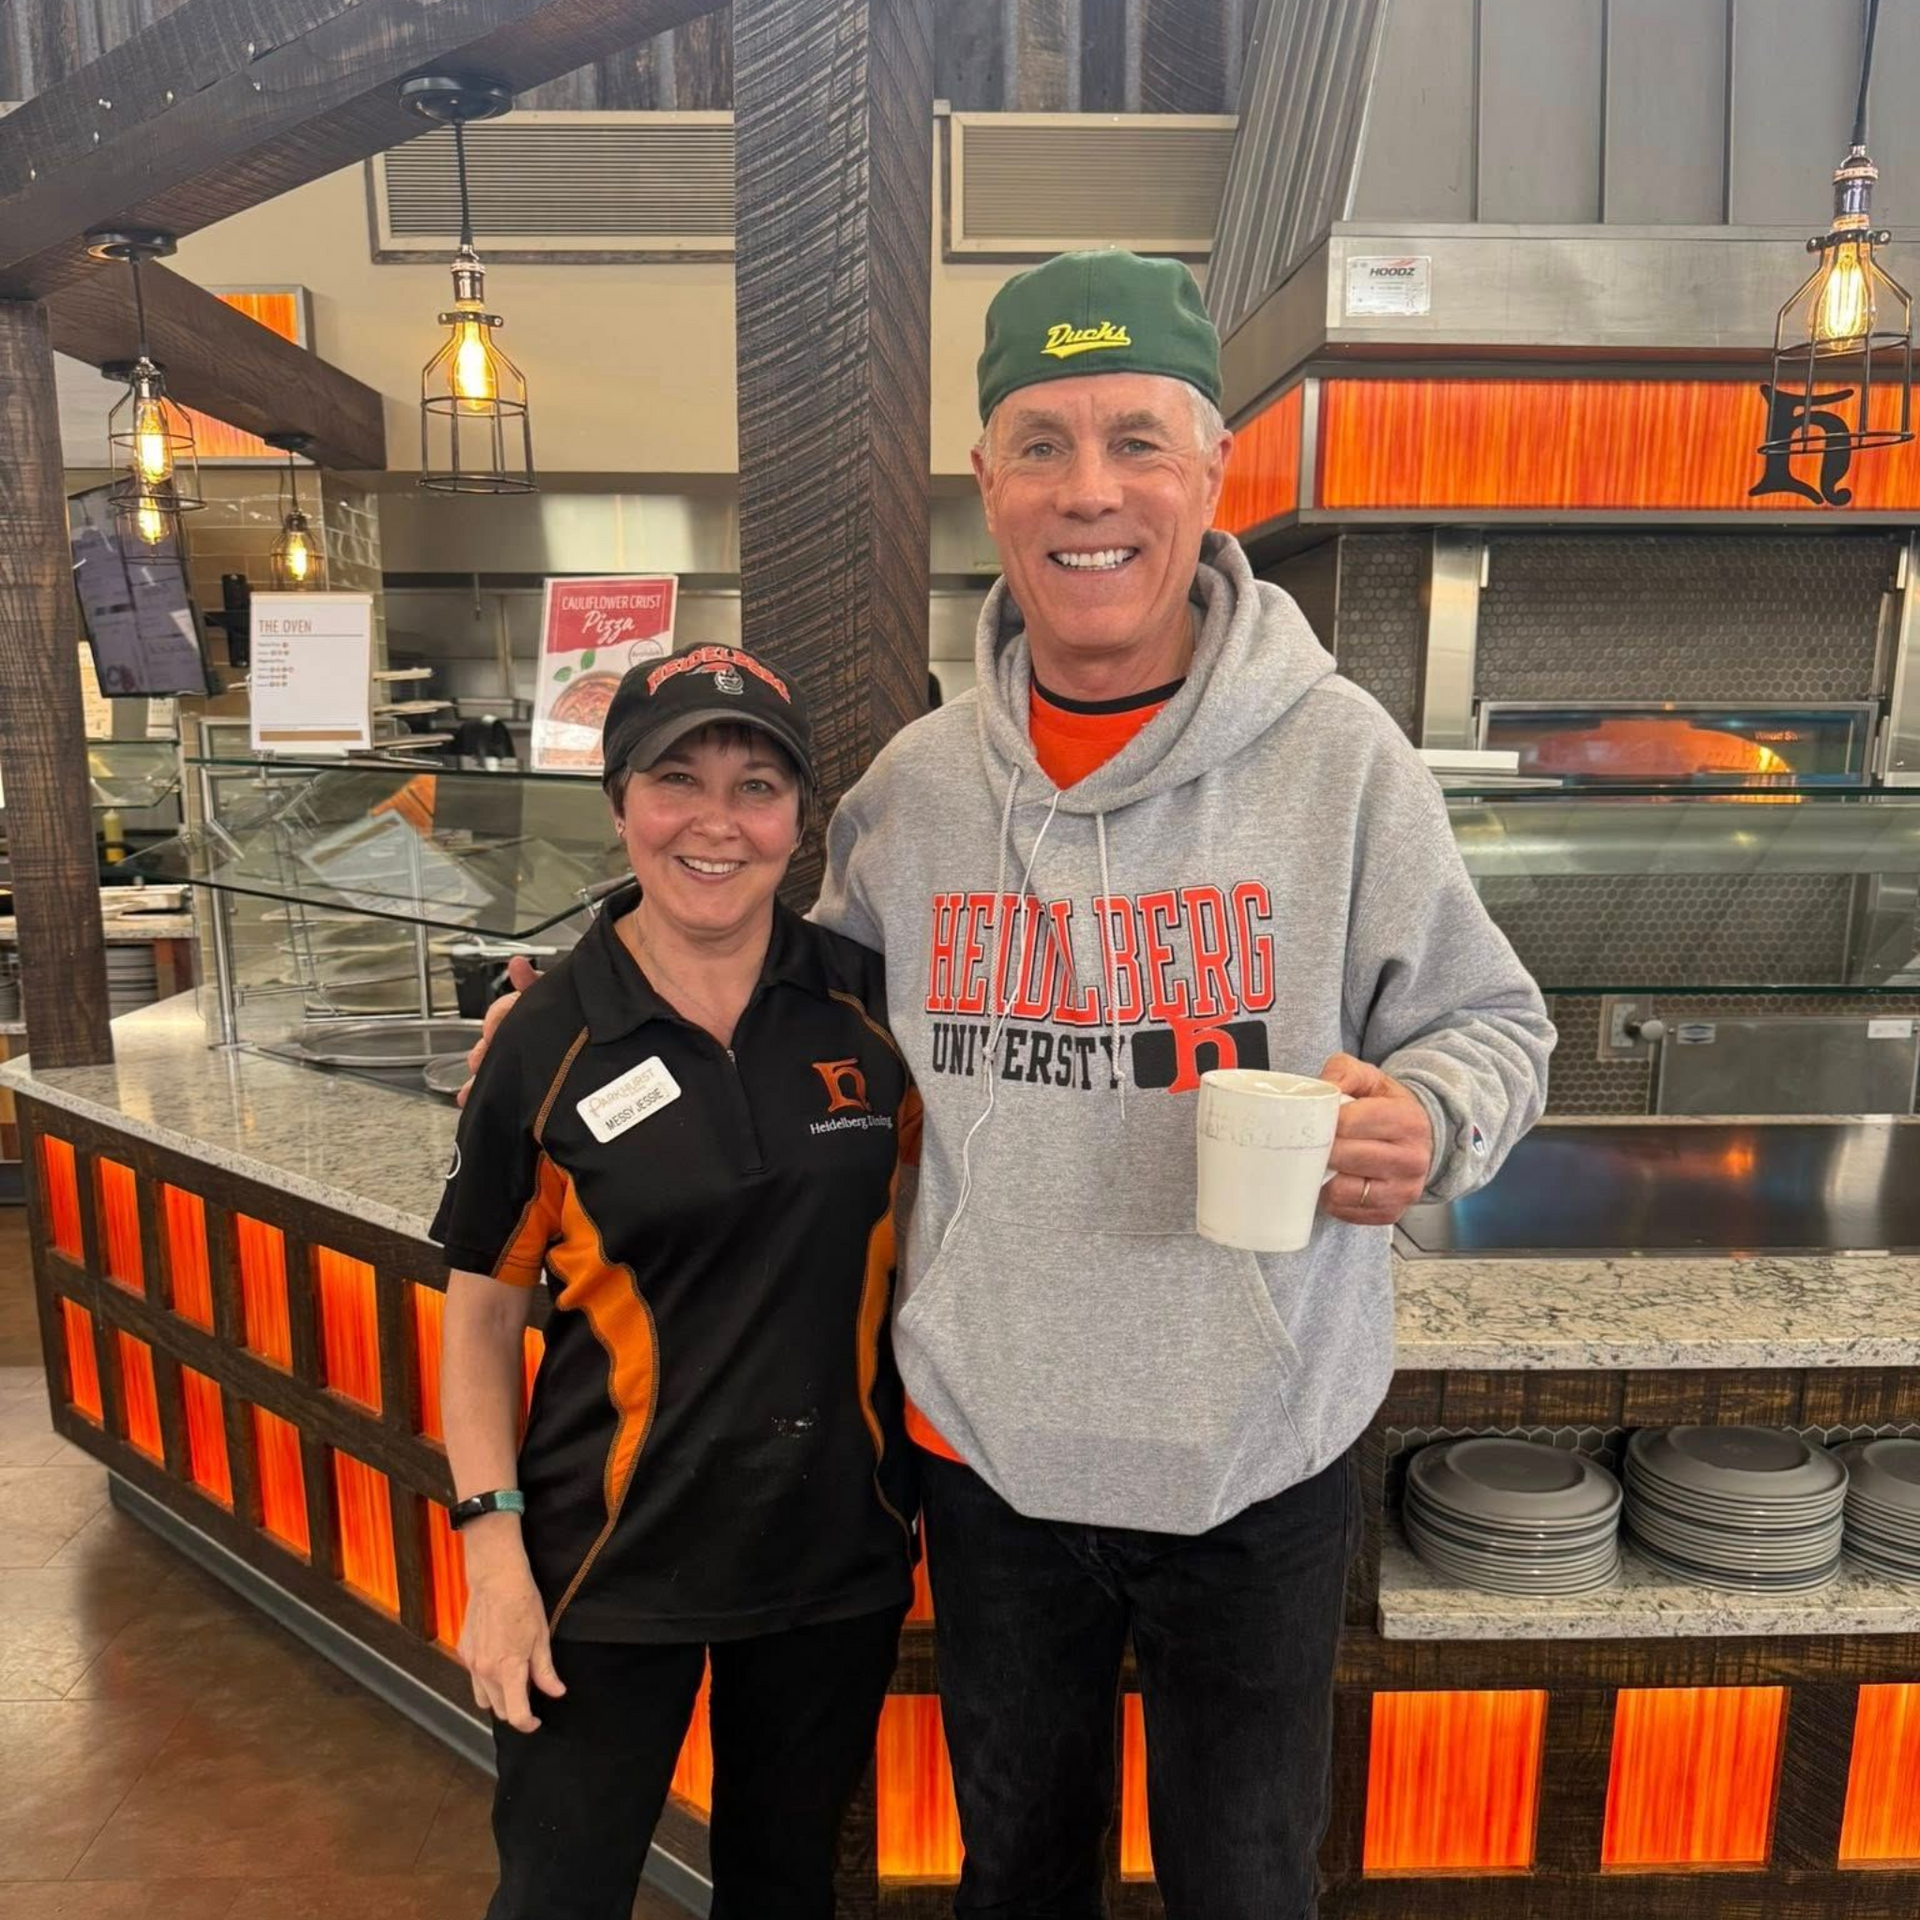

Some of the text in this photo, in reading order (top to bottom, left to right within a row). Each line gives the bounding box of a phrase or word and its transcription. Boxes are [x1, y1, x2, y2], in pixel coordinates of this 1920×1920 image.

[1369, 267, 1416, 277] HOODZ
[1043, 321, 1129, 352] Ducks
[561, 594, 662, 611] CAULIFLOWER CRUST
[259, 619, 312, 633] THE OVEN
[581, 610, 636, 645] Pizza
[925, 880, 1276, 1027] HEIDLBERG
[588, 1067, 656, 1118] PARKHURST
[605, 1105, 636, 1131] MESSY
[635, 1087, 664, 1113] JESSIE
[809, 1117, 869, 1135] Heidelberg
